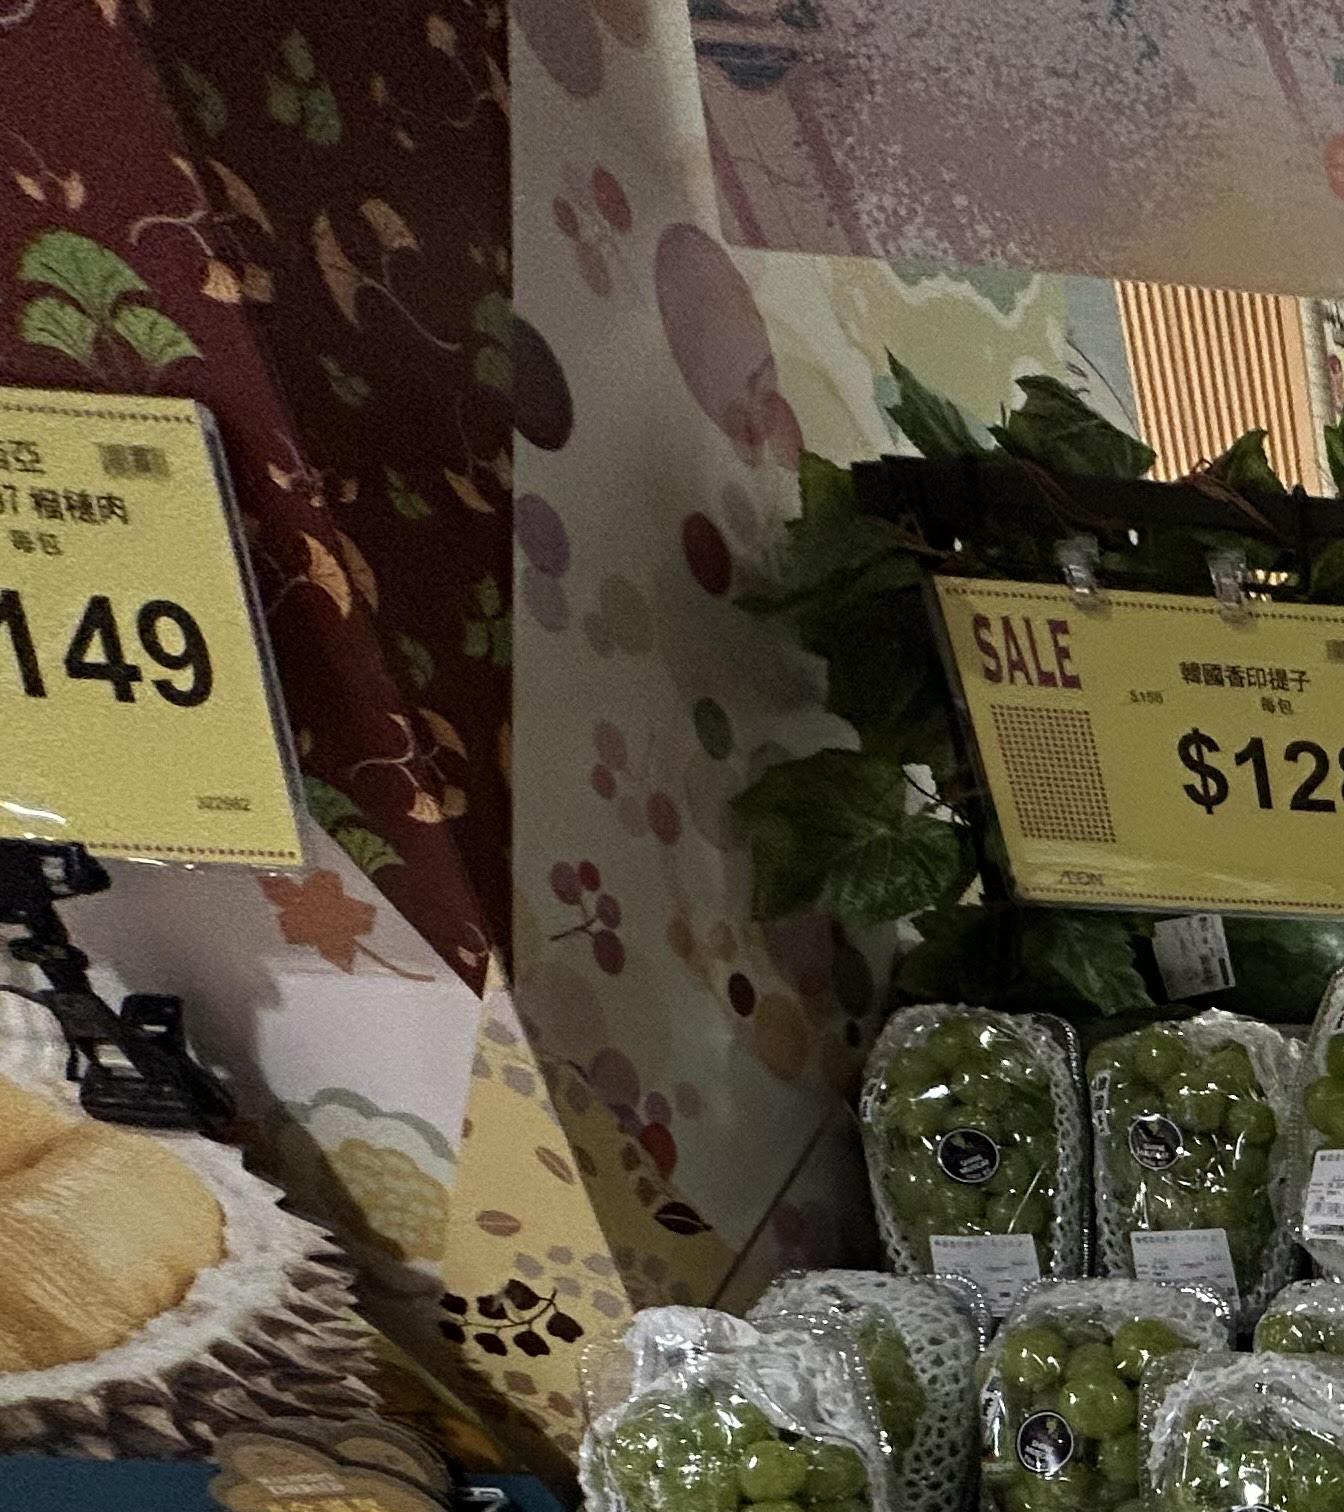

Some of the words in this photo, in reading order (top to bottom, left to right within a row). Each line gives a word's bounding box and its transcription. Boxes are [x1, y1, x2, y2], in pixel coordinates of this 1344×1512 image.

[971, 613, 1083, 691] SALE
[1179, 660, 1311, 693] 韓國香印提子
